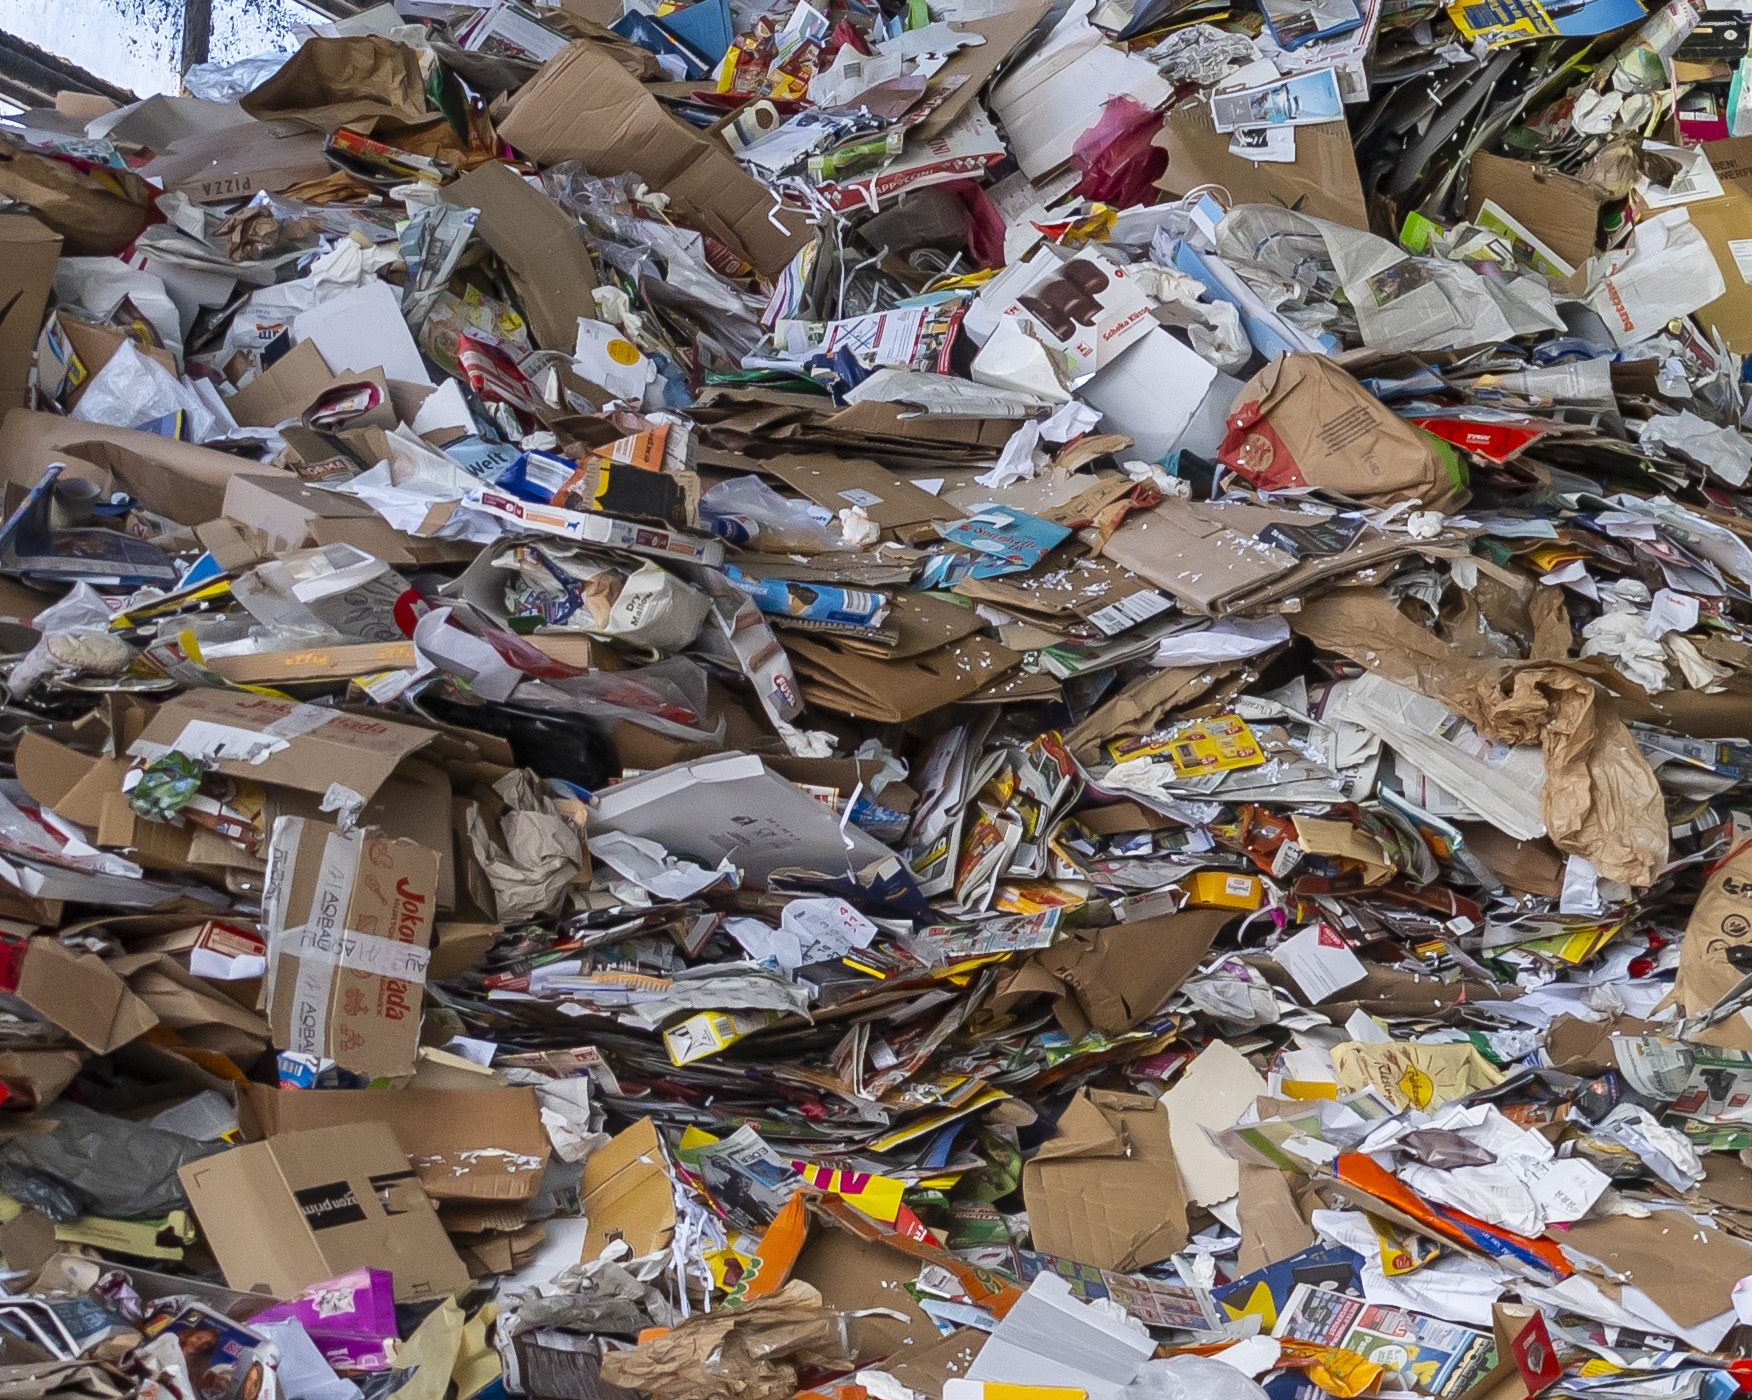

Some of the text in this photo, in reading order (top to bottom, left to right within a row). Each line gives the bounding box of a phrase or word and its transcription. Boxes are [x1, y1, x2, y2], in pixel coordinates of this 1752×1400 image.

[201, 176, 252, 195] PIZZA
[465, 451, 509, 478] Welt
[626, 593, 641, 613] Dry
[775, 677, 797, 709] FUSSL
